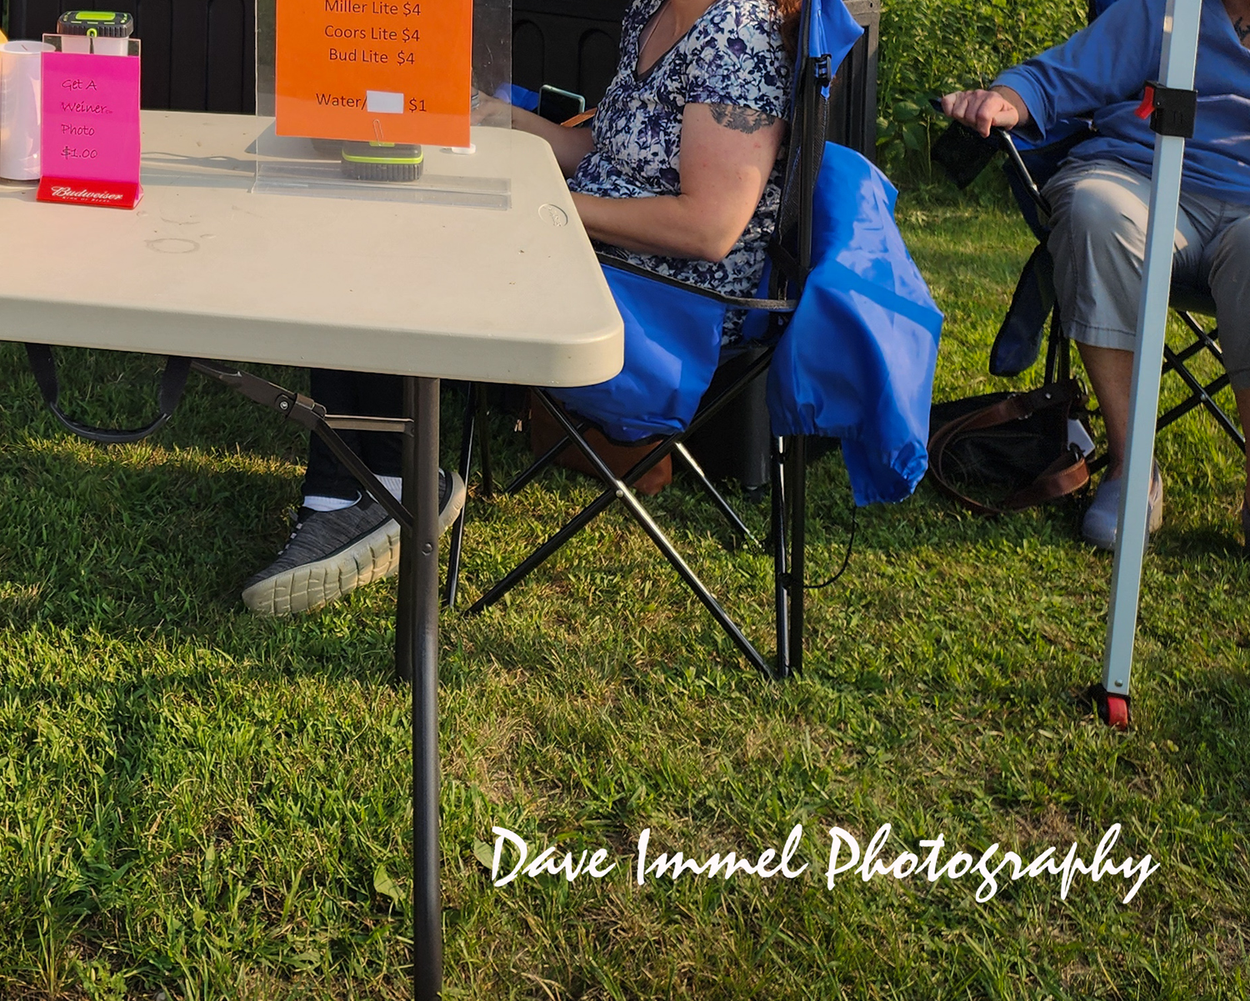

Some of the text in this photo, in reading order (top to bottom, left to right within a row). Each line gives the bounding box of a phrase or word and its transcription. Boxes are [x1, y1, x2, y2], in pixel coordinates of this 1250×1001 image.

[325, 0, 421, 17] Miller Lite $4
[325, 26, 420, 43] Coors Lite $4
[329, 49, 415, 66] Bud Lite $4
[62, 79, 97, 91] Get A
[61, 101, 107, 113] Weiner
[409, 97, 426, 112] $1
[61, 124, 95, 136] Photo
[61, 146, 98, 160] $1.00
[51, 186, 123, 199] Budweiser
